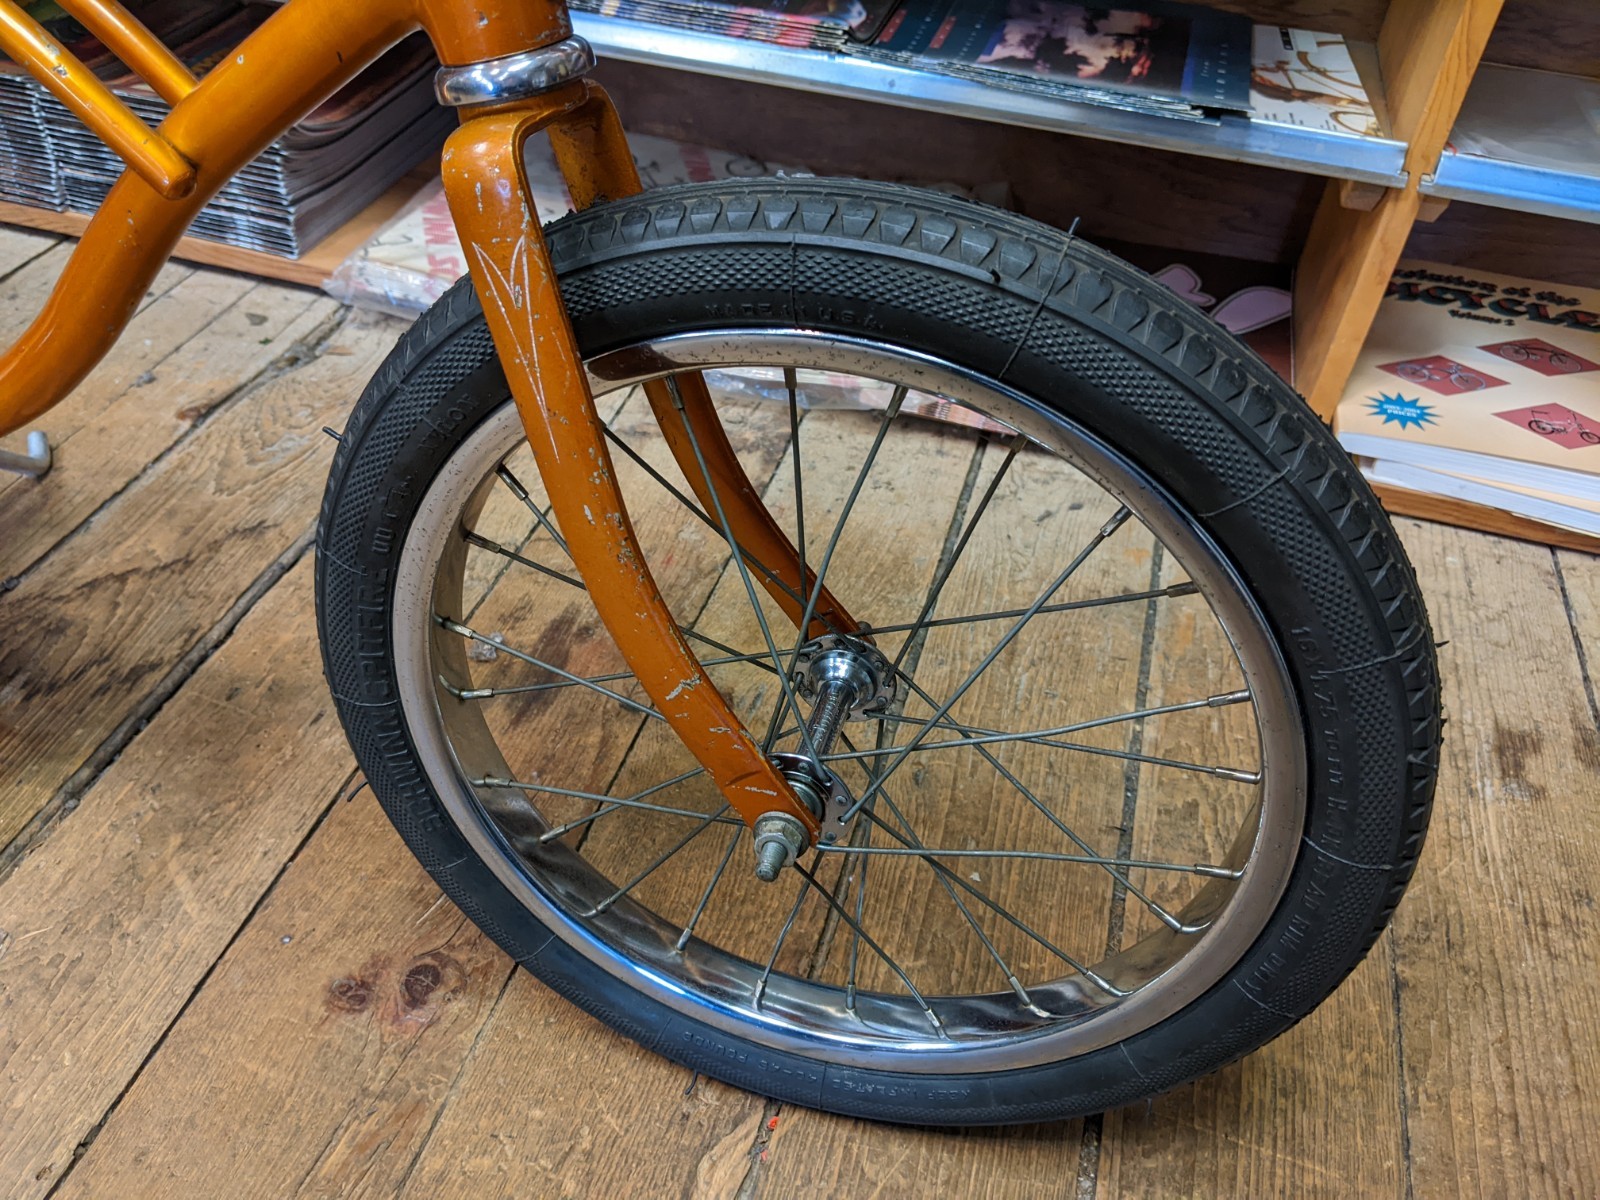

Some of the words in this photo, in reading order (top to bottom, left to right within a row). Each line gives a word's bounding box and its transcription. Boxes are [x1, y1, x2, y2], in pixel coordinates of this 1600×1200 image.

[704, 302, 773, 319] MADE
[781, 303, 808, 319] IN
[356, 565, 390, 697] SPITFIRE
[371, 707, 441, 833] SCHWINN
[1279, 913, 1312, 952] RIM
[682, 1030, 750, 1065] POUNDS
